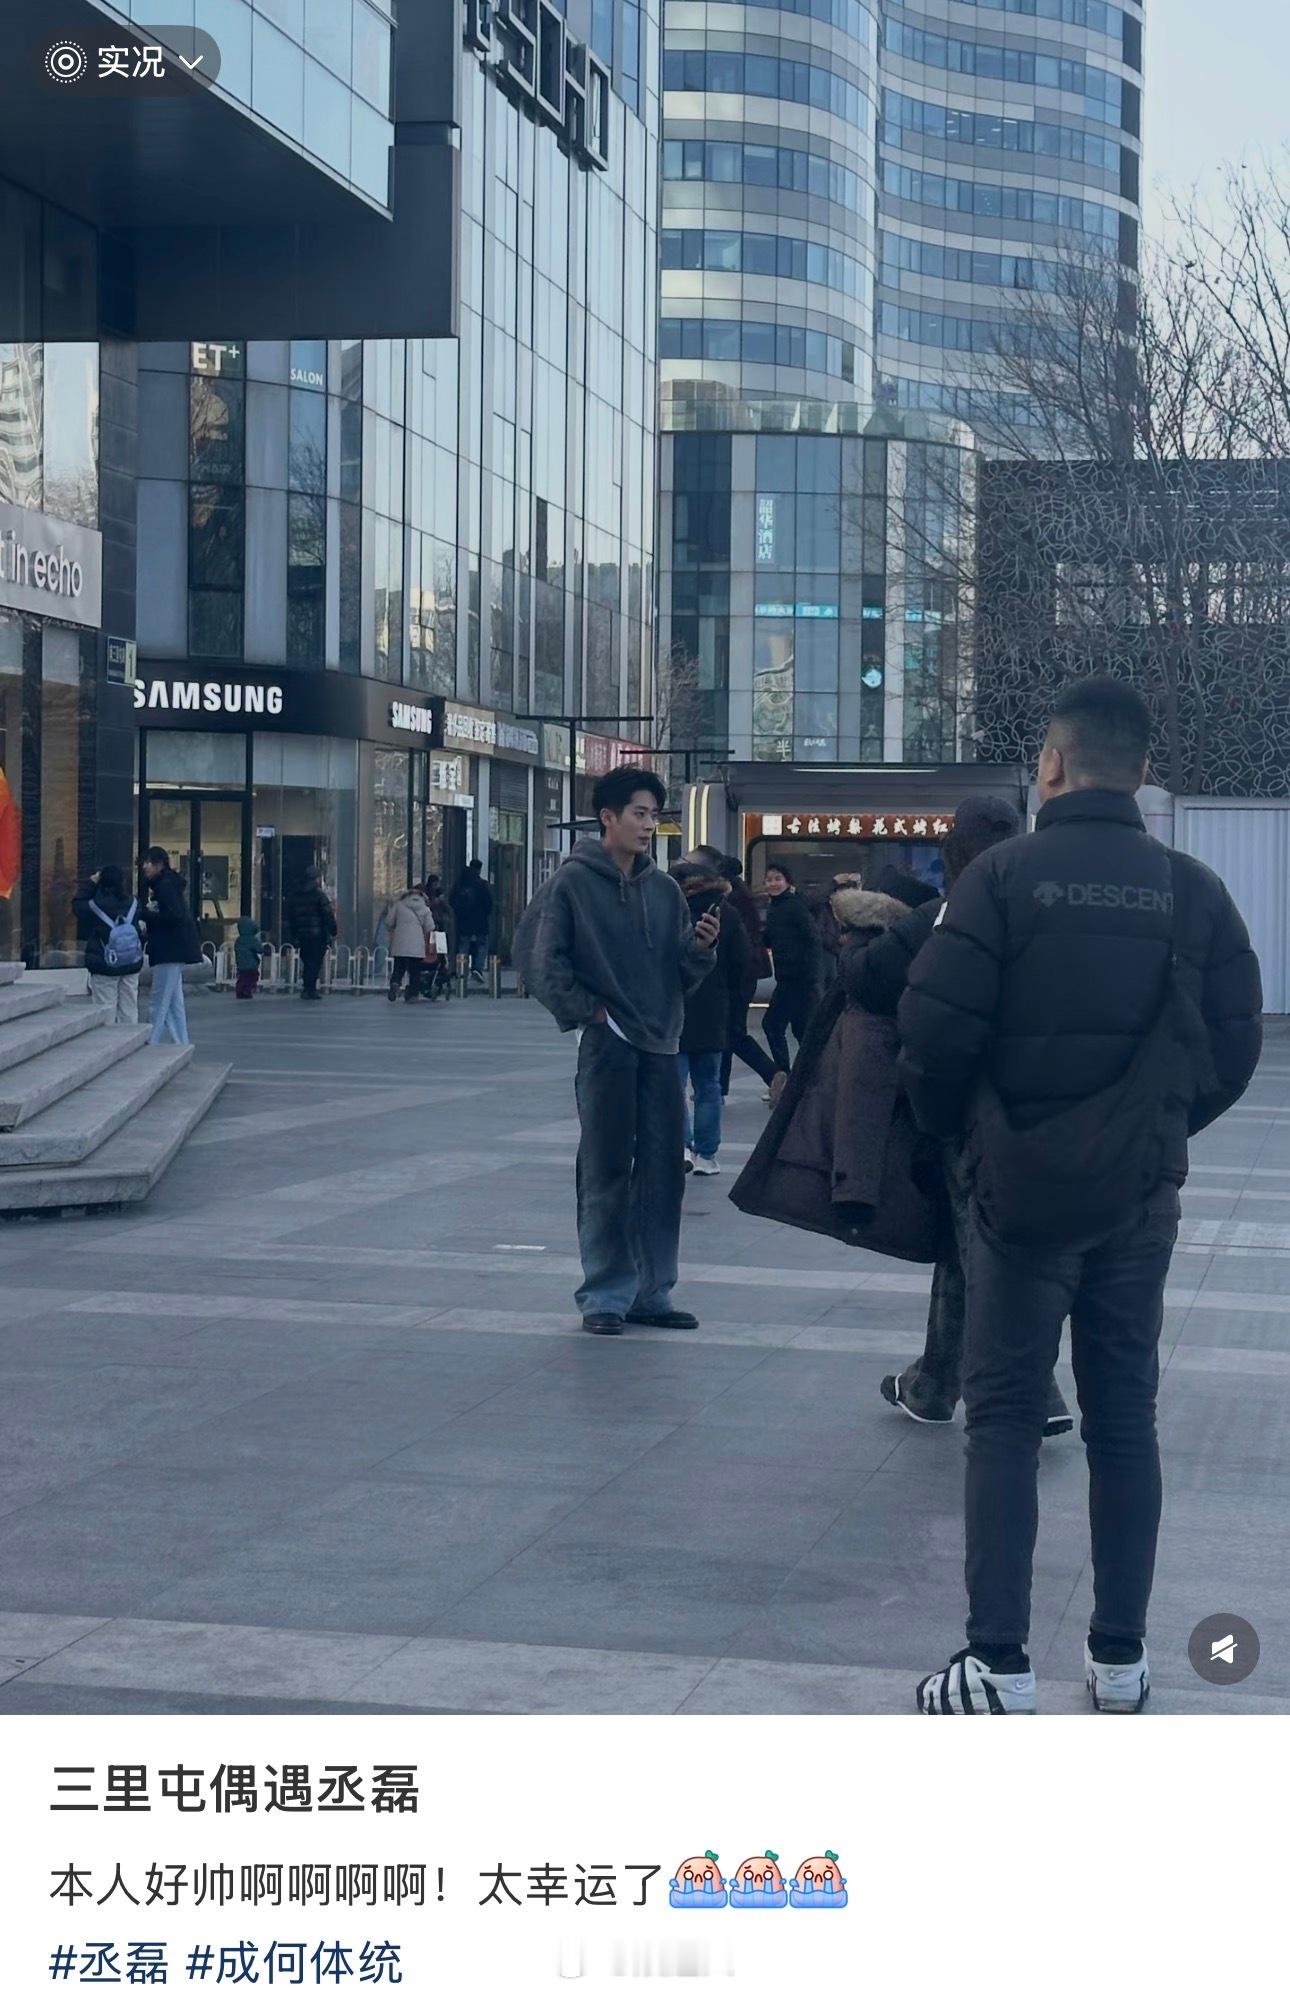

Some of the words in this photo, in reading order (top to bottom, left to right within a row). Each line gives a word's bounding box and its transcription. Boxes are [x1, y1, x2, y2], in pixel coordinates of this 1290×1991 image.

[290, 368, 323, 386] SALON
[12, 529, 30, 585] in
[34, 545, 83, 597] echo
[133, 679, 283, 714] SAMSUNG
[391, 700, 432, 735] SAMSUNG
[872, 816, 955, 836] 花式烤红
